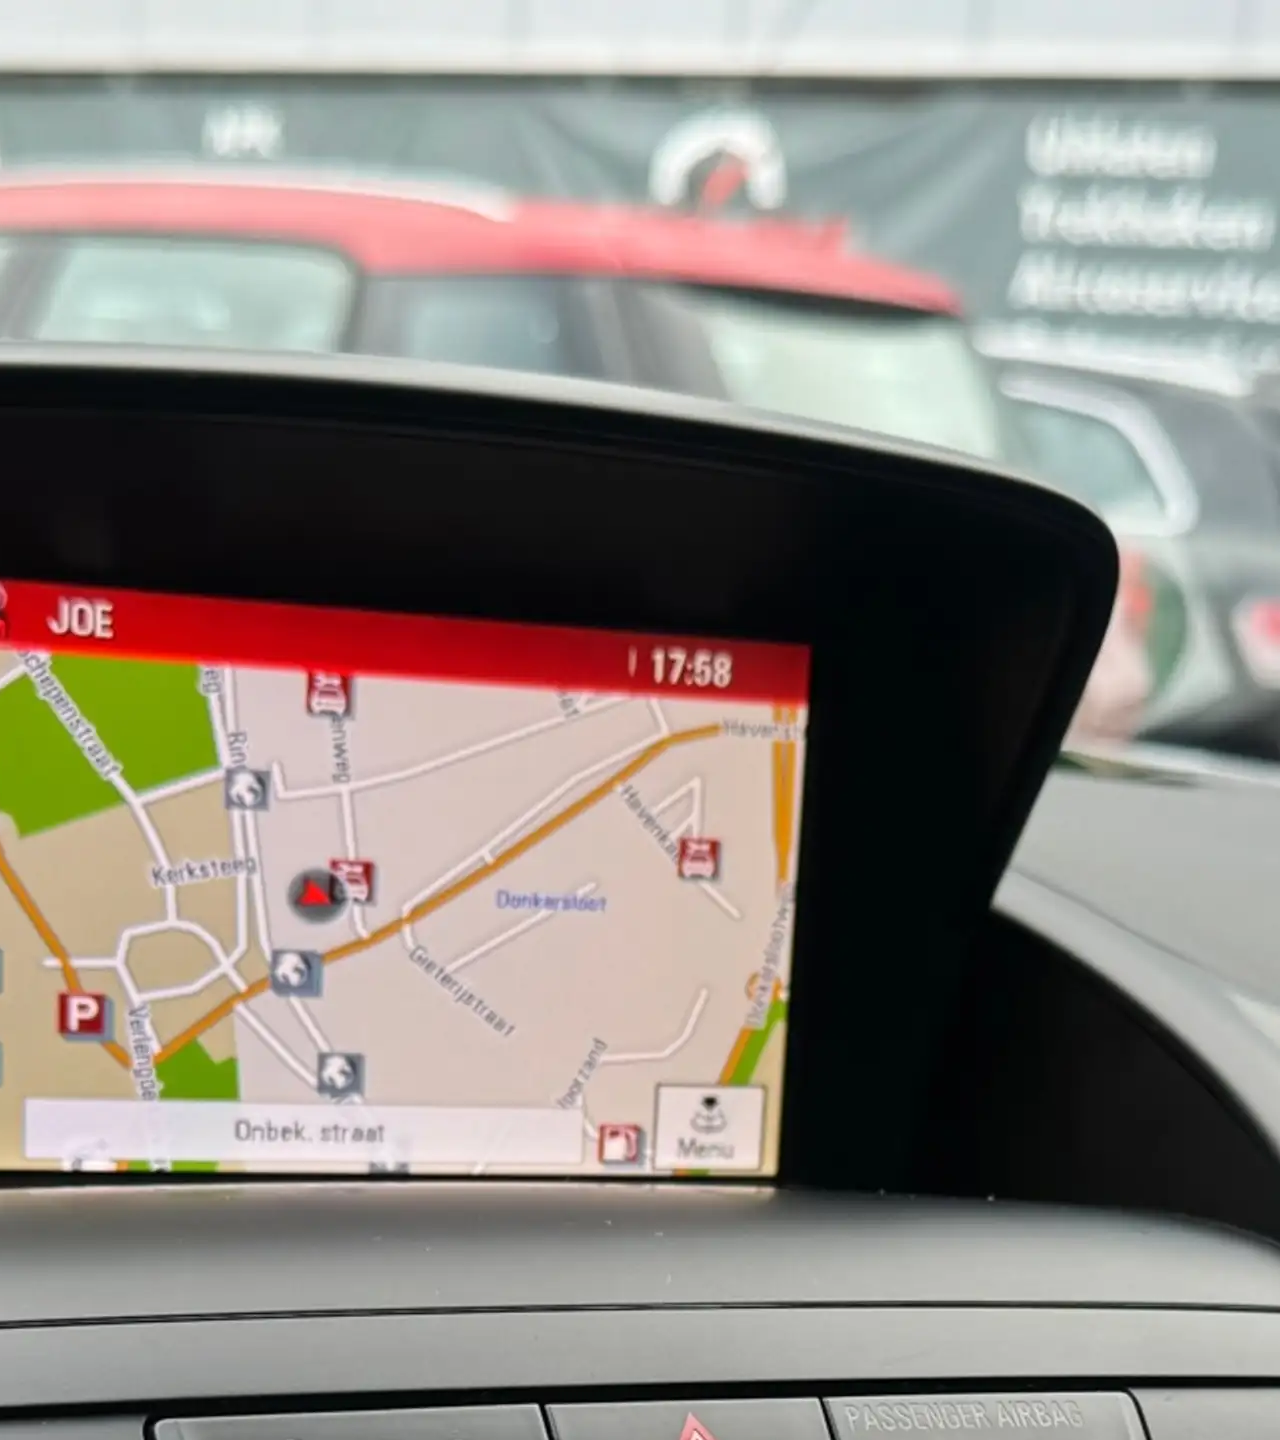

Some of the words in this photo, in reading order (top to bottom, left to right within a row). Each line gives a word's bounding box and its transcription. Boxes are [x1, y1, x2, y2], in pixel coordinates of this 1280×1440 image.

[46, 597, 114, 639] JOE
[652, 645, 733, 688] 17:58
[234, 1119, 314, 1143] Onbek.
[320, 1123, 385, 1143] straat
[676, 1137, 736, 1160] Menu
[844, 1402, 991, 1431] PASSENGER
[997, 1400, 1085, 1430] AIRBAG
